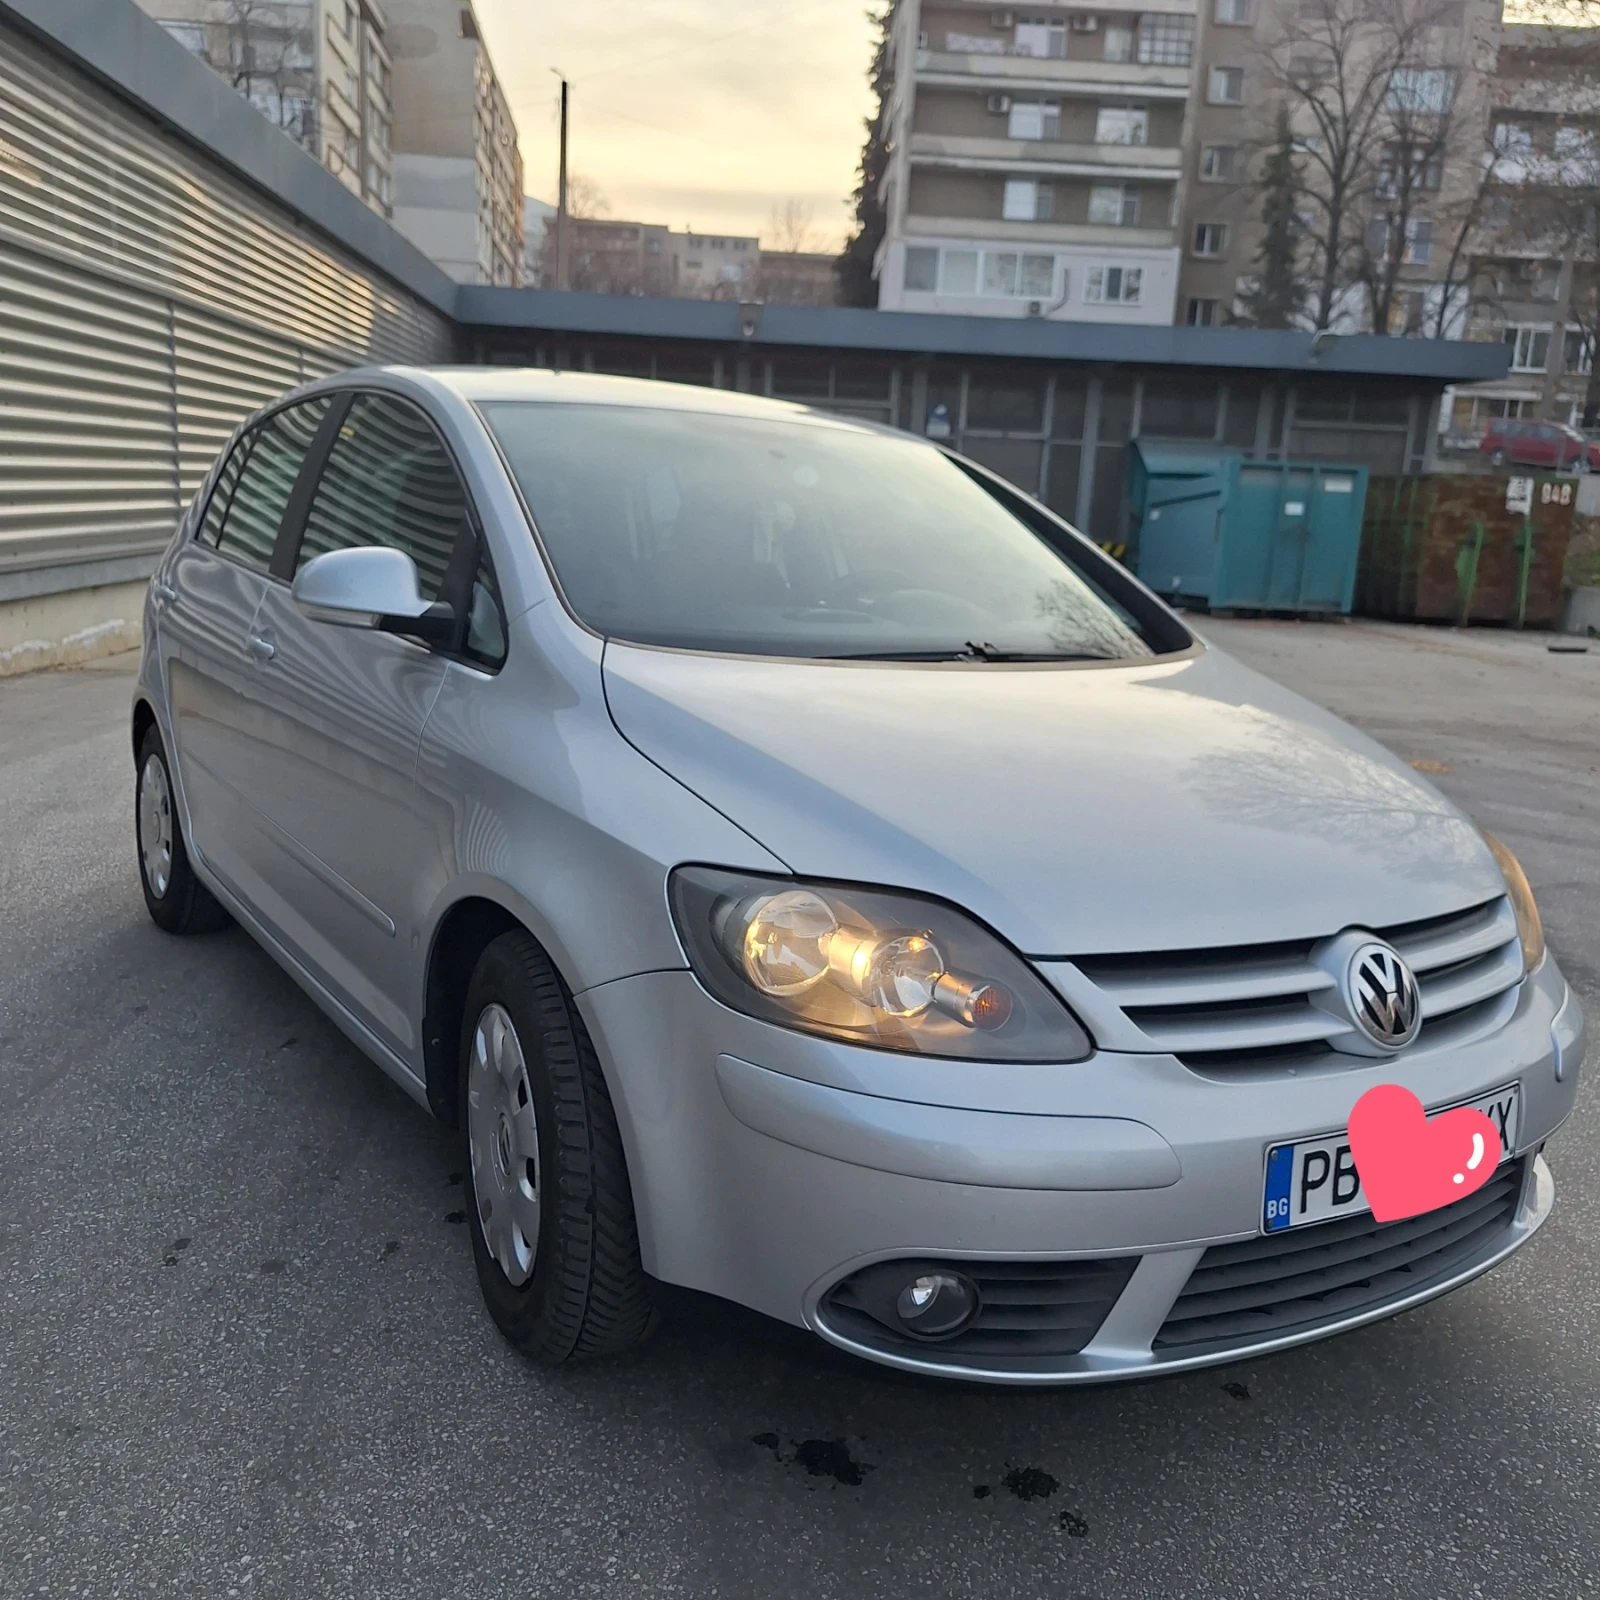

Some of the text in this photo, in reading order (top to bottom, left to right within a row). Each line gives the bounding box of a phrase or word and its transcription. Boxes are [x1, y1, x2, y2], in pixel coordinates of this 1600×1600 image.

[1351, 946, 1416, 1042] VW
[1478, 1096, 1513, 1151] X
[1267, 1198, 1289, 1219] BG
